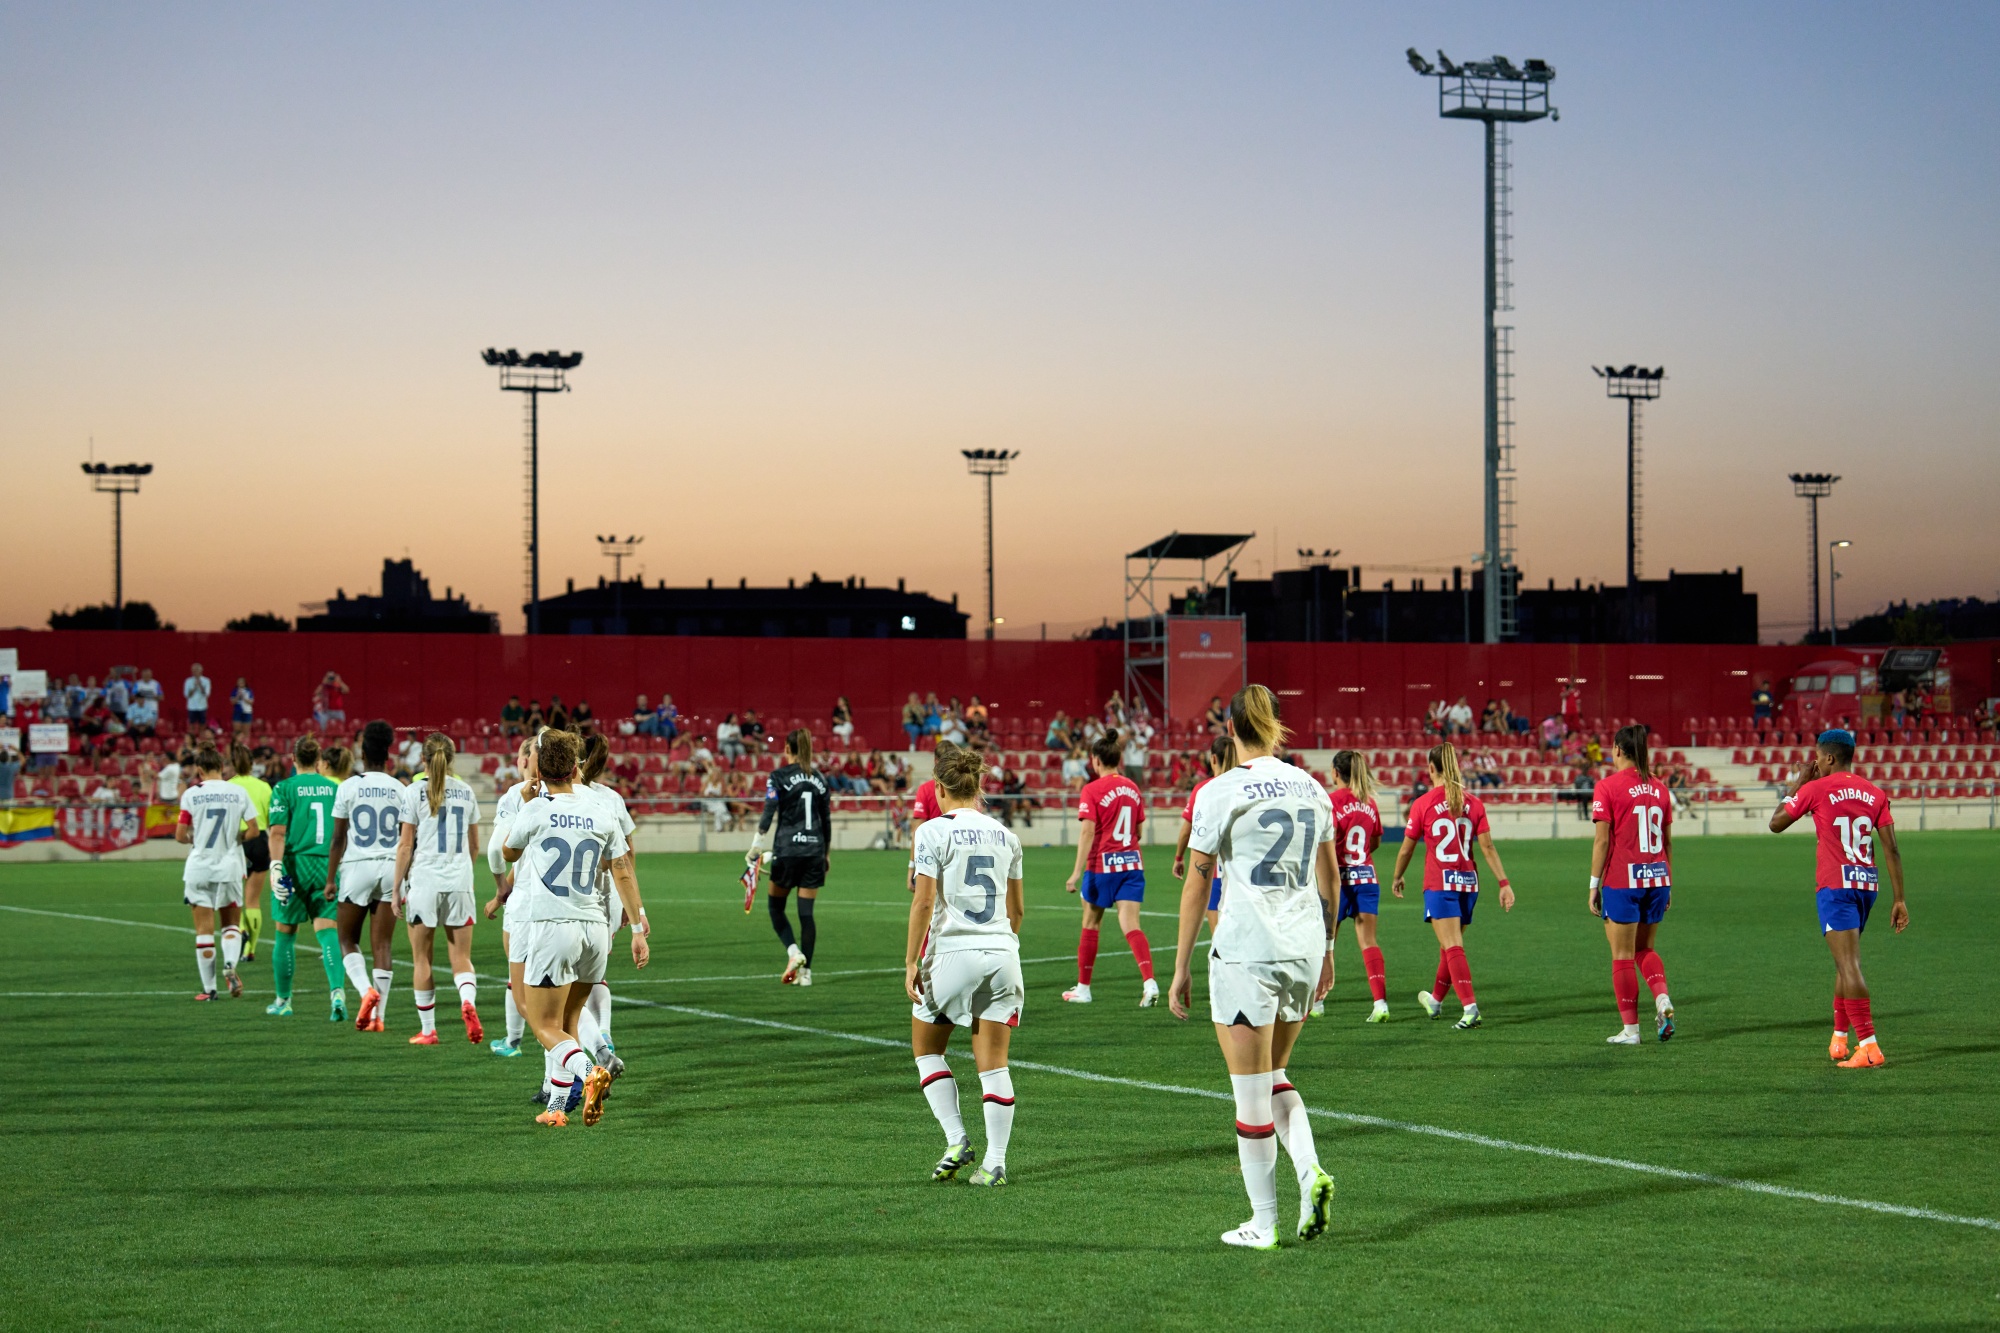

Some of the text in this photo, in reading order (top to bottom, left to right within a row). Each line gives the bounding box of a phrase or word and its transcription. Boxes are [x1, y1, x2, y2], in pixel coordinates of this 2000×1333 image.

[801, 791, 812, 830] 1
[1100, 790, 1117, 808] VAN
[1629, 784, 1660, 799] SHEILA
[1828, 788, 1876, 806] AJIBADE
[205, 808, 226, 848] 7
[310, 802, 324, 844] 1
[352, 804, 399, 848] 99
[438, 806, 464, 853] 11
[550, 813, 594, 830] SOFFIA
[792, 832, 808, 842] ria
[1112, 806, 1131, 847] 4
[1431, 817, 1473, 862] 20
[1633, 805, 1663, 854] 18
[1833, 816, 1873, 865] 16
[1108, 853, 1124, 865] ria
[1251, 808, 1316, 887] 21
[1344, 825, 1366, 865] 9
[540, 836, 600, 897] 20
[1341, 868, 1358, 879] ria
[1448, 871, 1464, 884] ria
[1637, 865, 1653, 878] ria
[1849, 866, 1867, 882] ria
[964, 855, 997, 925] 5
